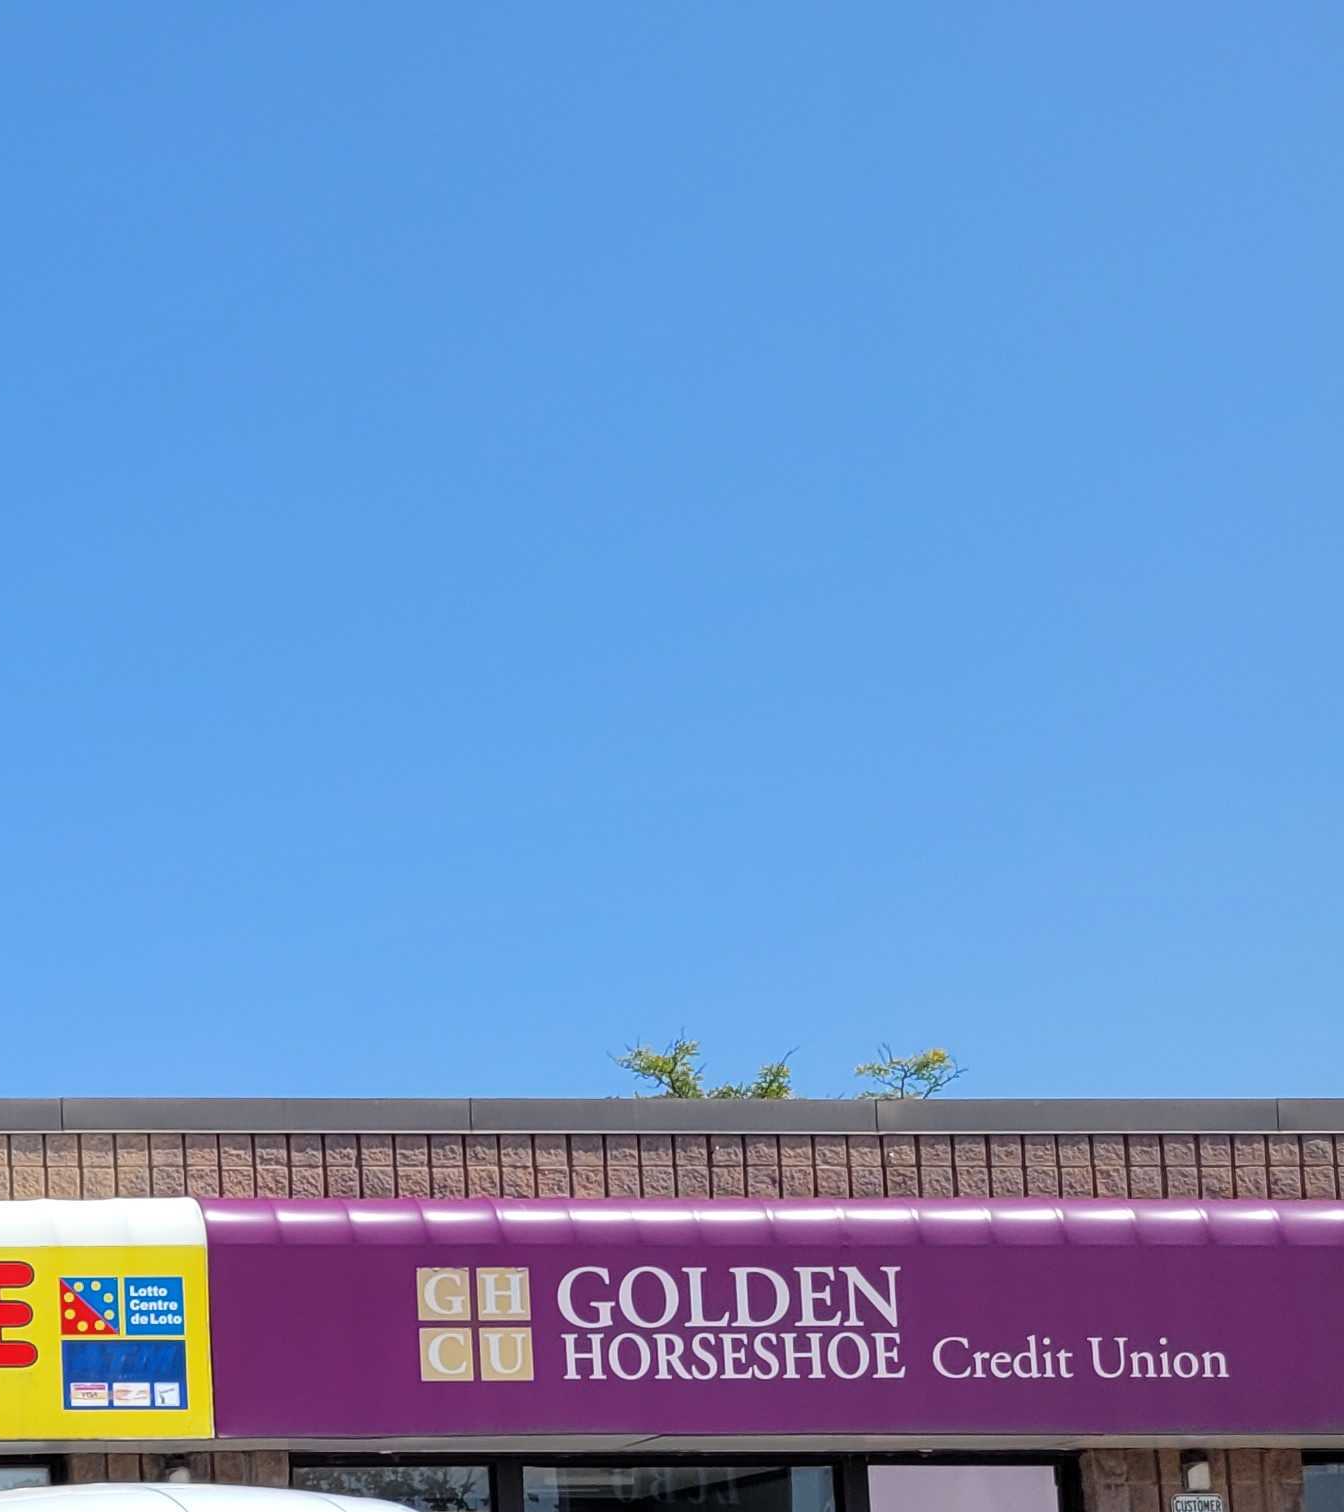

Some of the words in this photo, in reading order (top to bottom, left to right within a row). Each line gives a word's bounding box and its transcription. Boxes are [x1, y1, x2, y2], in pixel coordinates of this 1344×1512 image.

[129, 1285, 168, 1297] Lotto
[557, 1266, 900, 1329] GOLDEN
[129, 1299, 178, 1311] Centre
[130, 1313, 148, 1325] de
[149, 1313, 183, 1325] Loto
[561, 1332, 906, 1380] HORSESHOE
[932, 1335, 1073, 1379] Credit
[1088, 1337, 1229, 1378] Union
[1175, 1500, 1222, 1512] CUSTOMER
